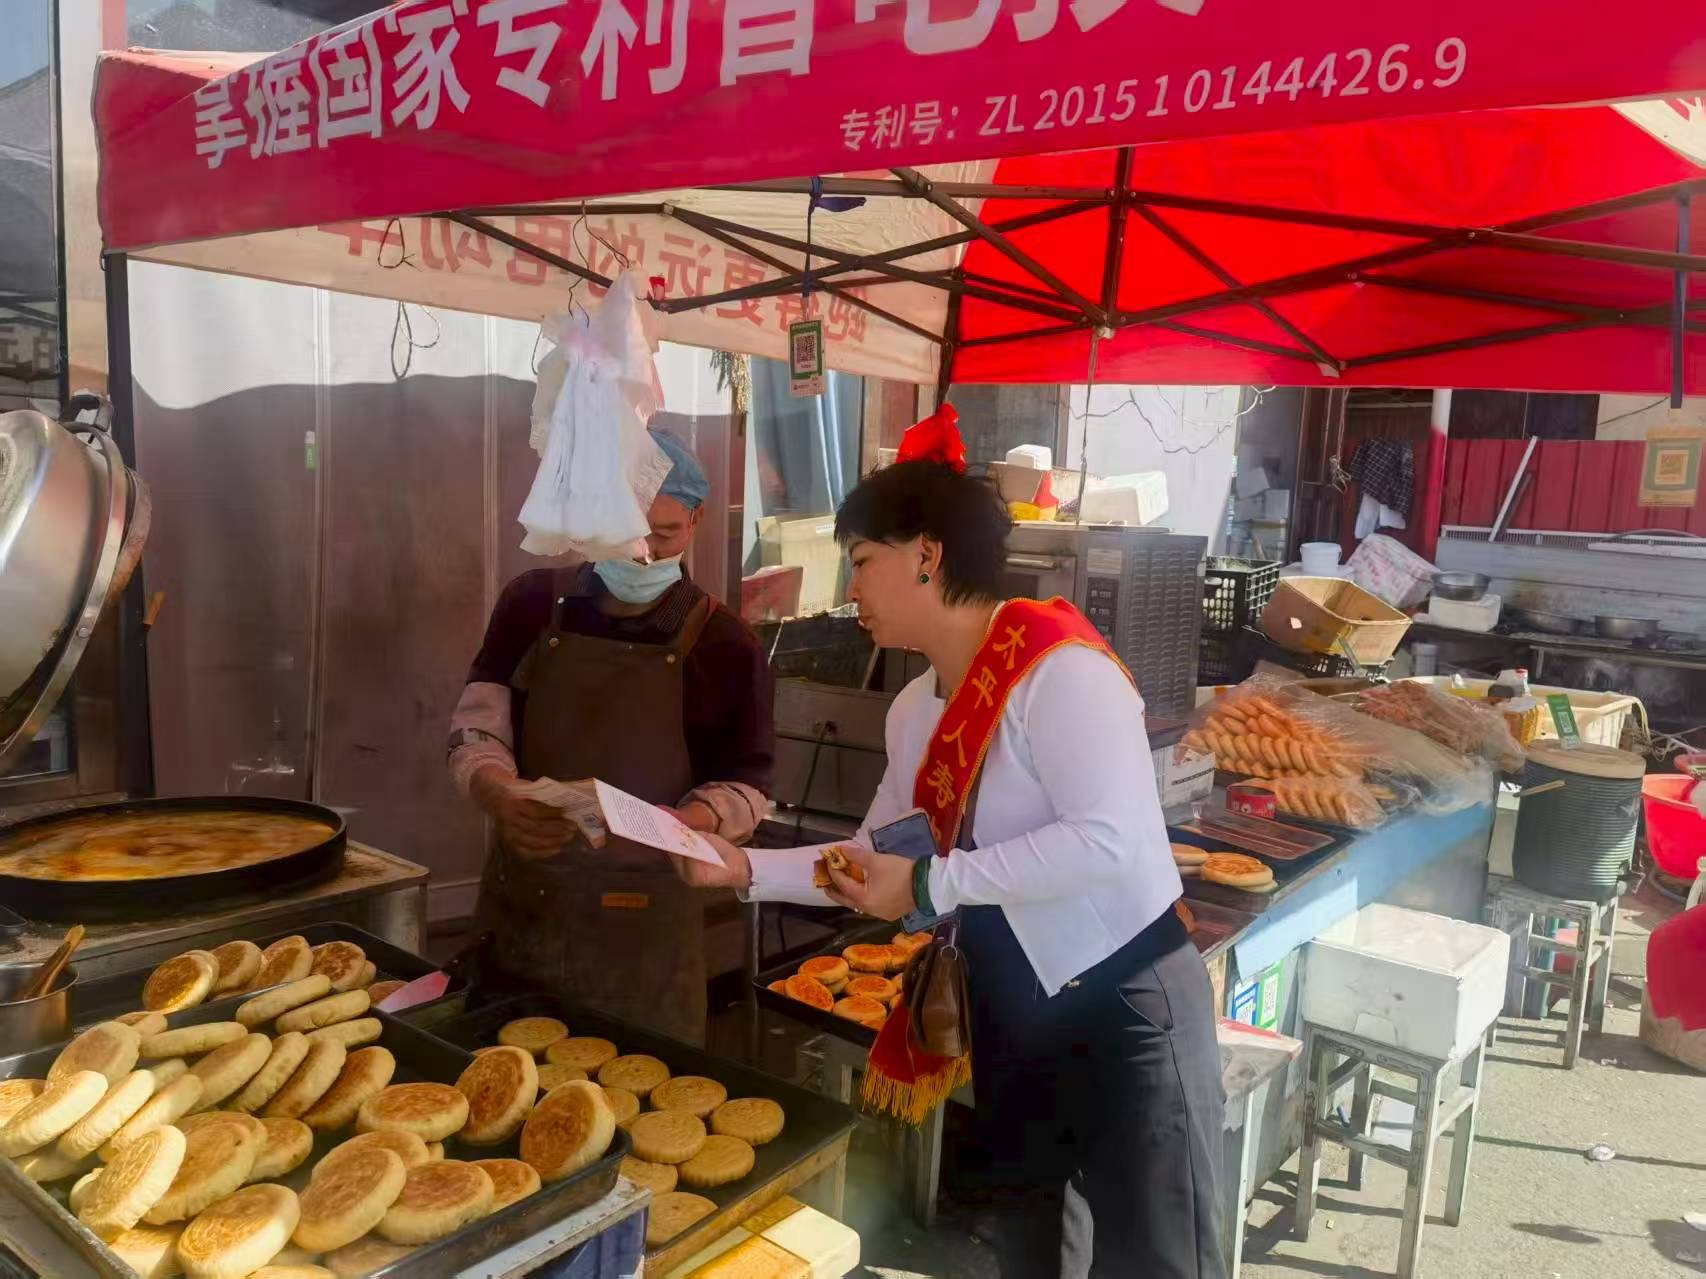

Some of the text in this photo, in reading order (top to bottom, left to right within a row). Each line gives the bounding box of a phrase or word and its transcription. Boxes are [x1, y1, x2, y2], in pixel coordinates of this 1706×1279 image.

[194, 0, 1198, 169] 掌握国家专利
[978, 95, 1025, 136] ZL
[1033, 78, 1138, 130] 2015
[1146, 74, 1169, 117] 1
[1183, 37, 1467, 113] 0144426.9
